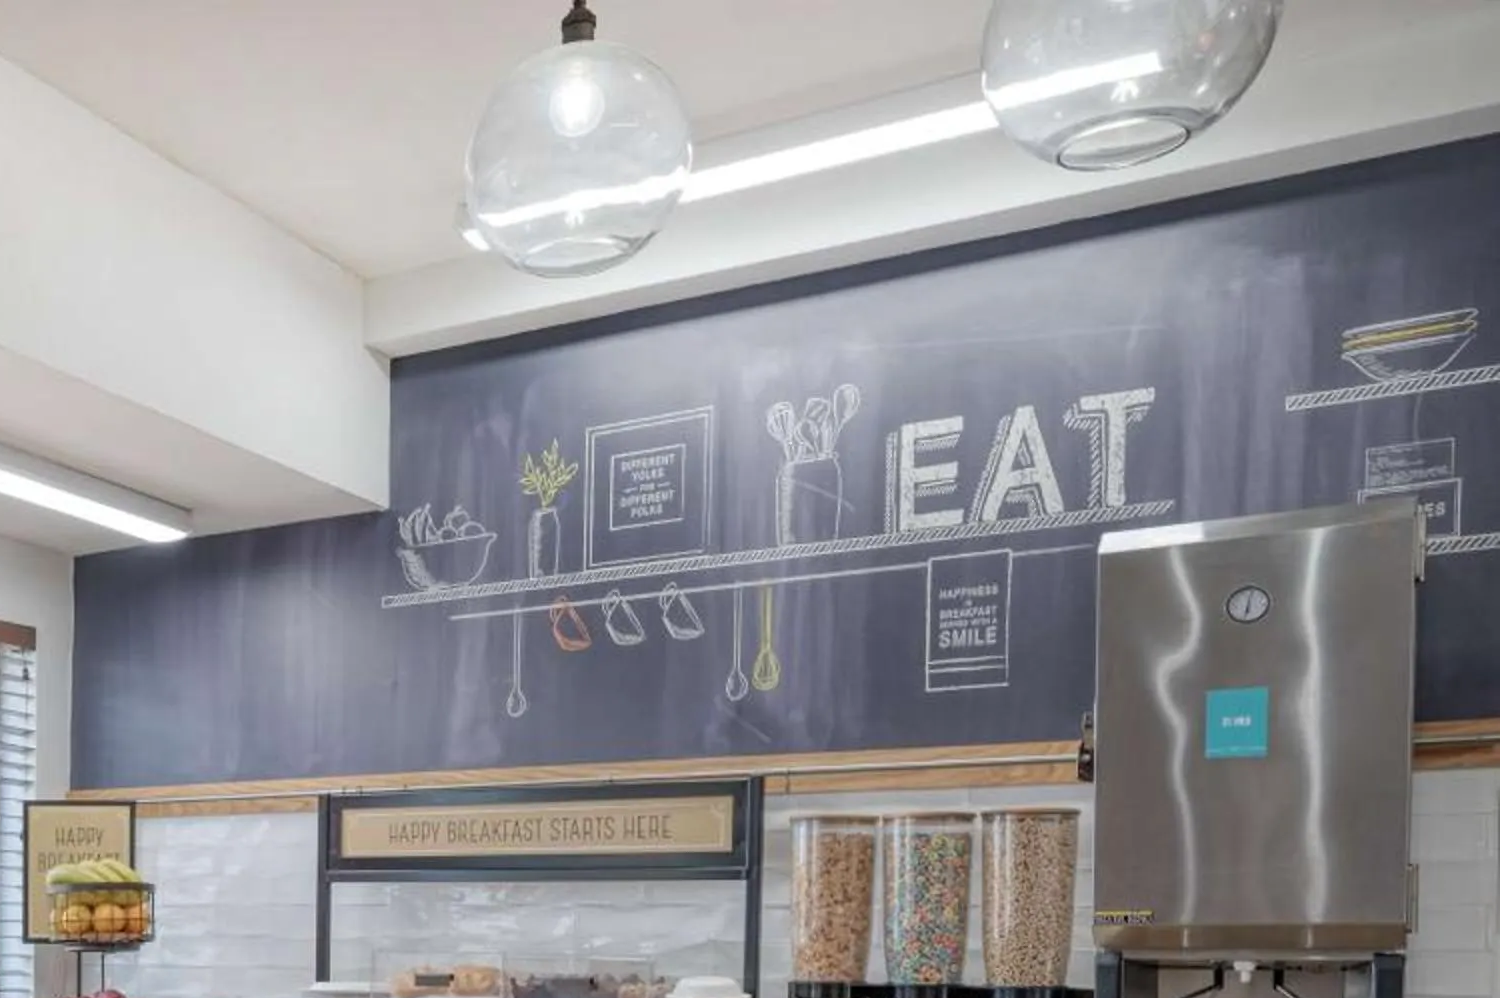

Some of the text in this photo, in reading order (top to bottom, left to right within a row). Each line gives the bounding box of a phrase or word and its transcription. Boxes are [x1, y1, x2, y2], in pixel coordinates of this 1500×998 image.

[884, 386, 1156, 535] EAT
[938, 626, 997, 649] SMILE
[55, 827, 105, 847] HAPPY
[389, 814, 673, 845] HAPPY BREAKFAST STARTS HERE
